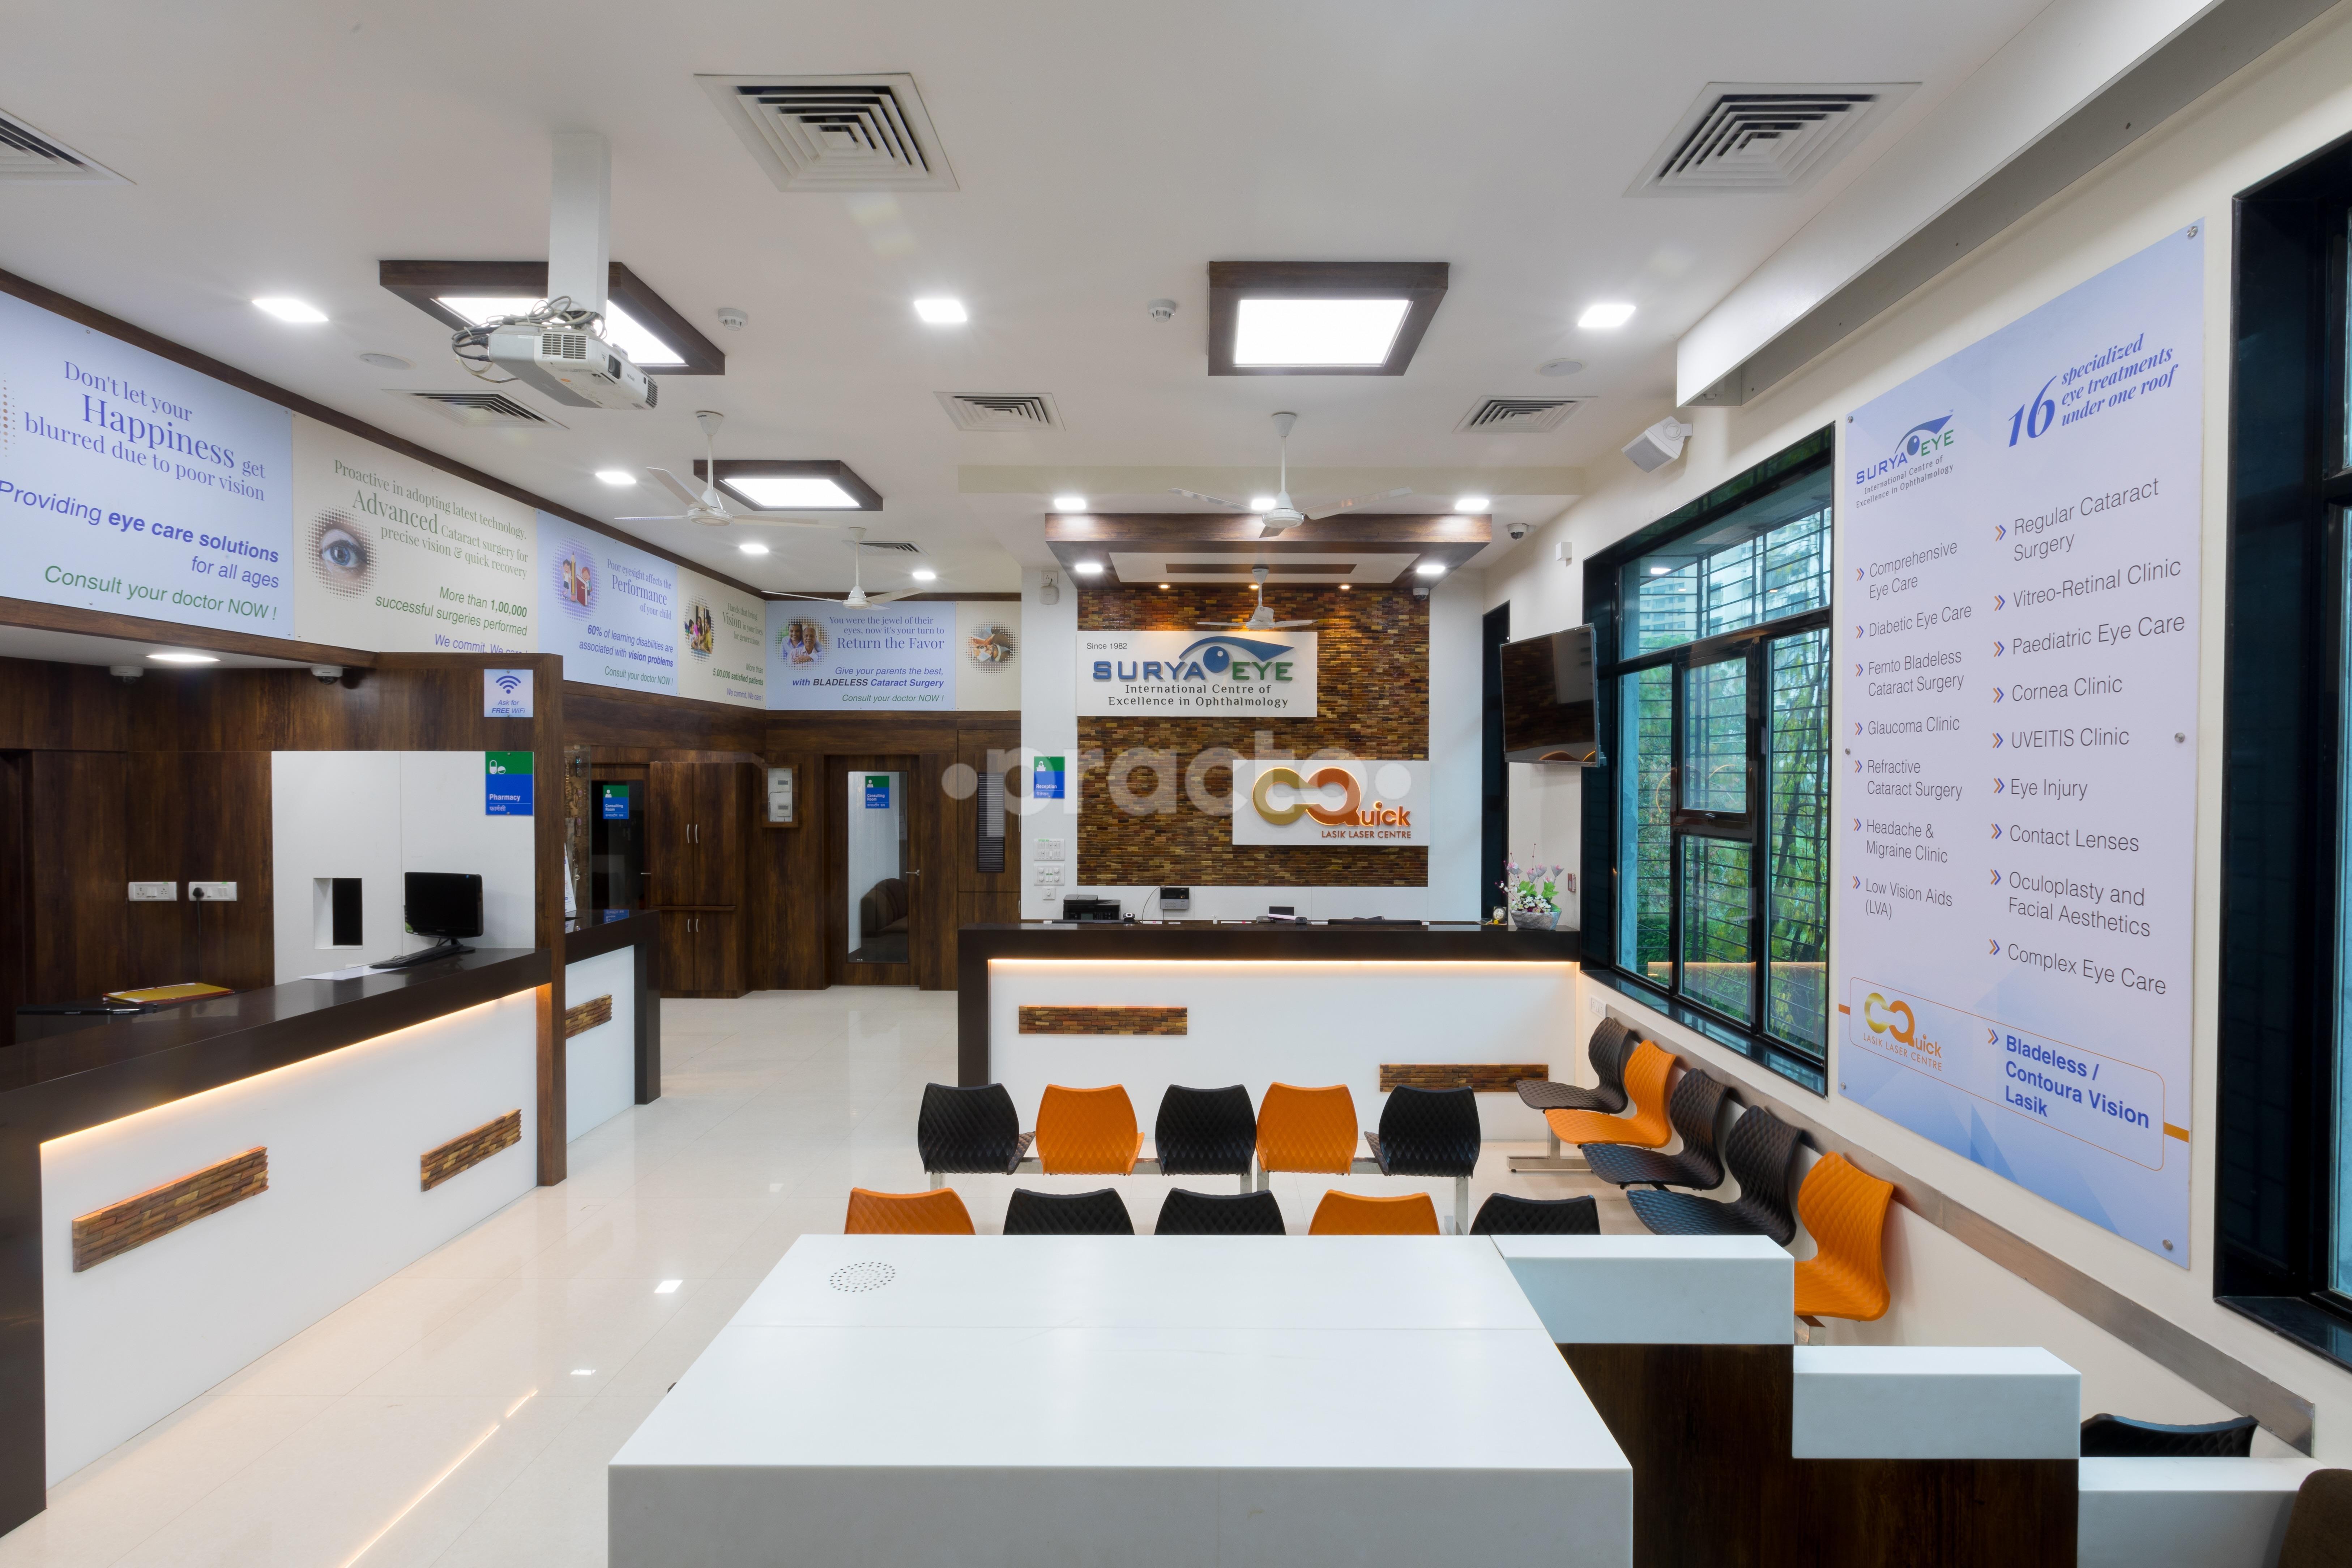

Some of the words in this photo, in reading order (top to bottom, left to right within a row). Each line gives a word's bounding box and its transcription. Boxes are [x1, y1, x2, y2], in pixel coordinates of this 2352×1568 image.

[2062, 333, 2144, 385] specialized
[65, 361, 118, 396] Don't
[124, 381, 146, 406] let
[151, 397, 192, 421] your
[2062, 386, 2084, 406] eye
[2088, 349, 2173, 394] treatments
[2062, 399, 2105, 426] under
[2109, 386, 2136, 407] one
[2141, 364, 2178, 394] roof
[2008, 376, 2057, 448] 16
[82, 394, 234, 468] Happiness
[242, 461, 265, 478] get
[25, 412, 104, 453] blurred
[112, 441, 146, 465] due
[153, 454, 170, 472] to
[176, 464, 215, 486] poor
[219, 476, 264, 501] vision
[1856, 452, 1908, 484] SURYA
[1921, 430, 1954, 457] EYE
[0, 480, 102, 525] Providing
[108, 513, 145, 532] eye
[152, 523, 193, 542] care
[199, 534, 278, 562] solutions
[2015, 506, 2074, 535] Regular
[2080, 478, 2159, 516] Cataract
[353, 490, 438, 534] Advanced
[441, 525, 480, 548] Cataract
[483, 541, 515, 560] surgery
[517, 549, 528, 562] for
[1870, 543, 1957, 577] Comprehensive
[2014, 534, 2074, 561] Surgery
[45, 565, 122, 594] Consult
[127, 584, 167, 601] your
[172, 590, 224, 611] doctor
[228, 599, 269, 618] NOW
[440, 586, 464, 603] More
[468, 594, 487, 608] than
[612, 575, 667, 605] Performance
[1870, 584, 1888, 601] Eye
[1892, 577, 1917, 593] Care
[2014, 569, 2120, 607] Vitreo-Retinal
[2128, 559, 2181, 584] Clinic
[376, 596, 434, 616] successful
[436, 610, 481, 626] surgeries
[483, 620, 528, 636] performed
[1869, 616, 1912, 637] Diabetic
[1917, 612, 1937, 629] Eye
[1942, 606, 1971, 622] Care
[588, 625, 602, 636] 60%
[611, 630, 635, 646] learning
[636, 637, 663, 650] disabilities
[838, 638, 880, 648] Return
[886, 637, 904, 649] the
[910, 638, 944, 649] Favor
[2013, 628, 2091, 654] Paediatric
[2099, 624, 2131, 645] Eye
[2138, 617, 2184, 636] Care
[579, 641, 614, 655] associated
[615, 648, 626, 657] with
[629, 650, 646, 661] vision
[648, 656, 673, 667] problems
[1869, 660, 1900, 675] Femto
[1905, 651, 1961, 670] Bladeless
[910, 679, 944, 688] Surgery
[1093, 661, 1205, 680] SURYA
[1233, 662, 1293, 680] EYE
[1869, 679, 1913, 696] Cataract
[1917, 675, 1964, 692] Surgery
[1109, 697, 1173, 705] Excellence
[1196, 697, 1288, 708] Ophthalmology
[1126, 685, 1206, 693] International
[1212, 684, 1253, 693] Centre
[1259, 685, 1271, 693] of
[2012, 684, 2068, 701] Cornea
[2074, 675, 2122, 696] Clinic
[1868, 721, 1922, 735] Glaucoma
[1926, 716, 1959, 732] Clinic
[2012, 729, 2074, 748] UVEITIS
[2080, 727, 2129, 746] Clinic
[1868, 759, 1920, 773] Refractive
[1867, 781, 1912, 795] Cataract
[1916, 781, 1962, 801] Surgery
[2011, 779, 2037, 799] Eye
[2044, 779, 2087, 801] Injury
[1867, 819, 1921, 837] Headache
[1926, 824, 1933, 838] &
[2010, 825, 2070, 846] Contact
[2076, 829, 2139, 851] Lenses
[1867, 840, 1911, 859] Migraine
[1916, 845, 1947, 863] Clinic
[1866, 878, 1886, 894] Low
[1890, 882, 1921, 901] Vision
[1926, 889, 1952, 906] Aids
[2010, 872, 2104, 904] Oculoplasty
[2110, 888, 2144, 906] and
[1866, 900, 1892, 920] (LVA)
[2009, 897, 2052, 920] Facial
[2058, 905, 2150, 937] Aesthetics
[2008, 944, 2076, 974] Complex
[2083, 959, 2114, 984] Eye
[2122, 968, 2165, 994] Care
[1864, 1033, 1882, 1047] LASIK
[1886, 1042, 1907, 1057] LASER
[1911, 1052, 1942, 1071] CENTRE
[2007, 1035, 2087, 1077] Bladeless
[2006, 1061, 2082, 1103] Contoura
[2089, 1090, 2148, 1128] Vision
[2006, 1085, 2047, 1117] Lasik
